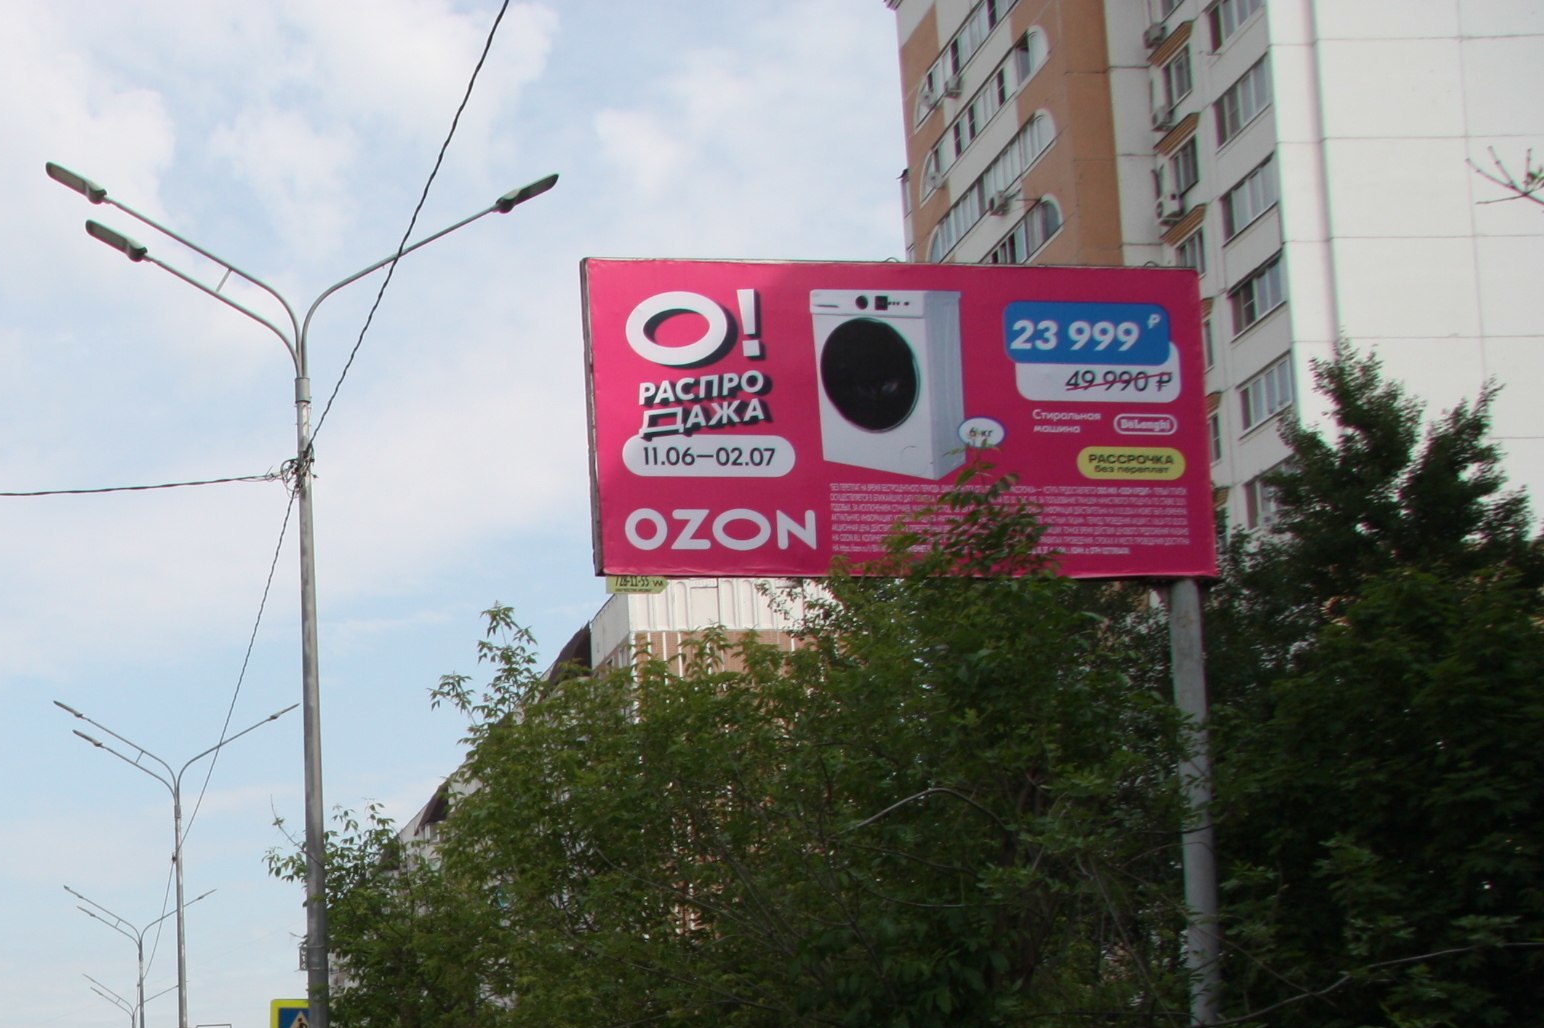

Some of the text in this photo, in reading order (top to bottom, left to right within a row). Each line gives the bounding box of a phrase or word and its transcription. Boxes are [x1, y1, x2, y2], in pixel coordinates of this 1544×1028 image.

[1010, 319, 1058, 350] 23
[1067, 320, 1140, 351] 999
[639, 370, 765, 405] РАСПРО
[1065, 369, 1096, 391] 49
[1102, 370, 1149, 392] 990
[639, 398, 766, 437] ДАЖА
[1032, 409, 1102, 421] Стиральная
[1033, 424, 1081, 434] машина
[1088, 453, 1175, 465] РАССРОЧКА
[1094, 465, 1170, 475] без переплат
[624, 508, 817, 551] OZON
